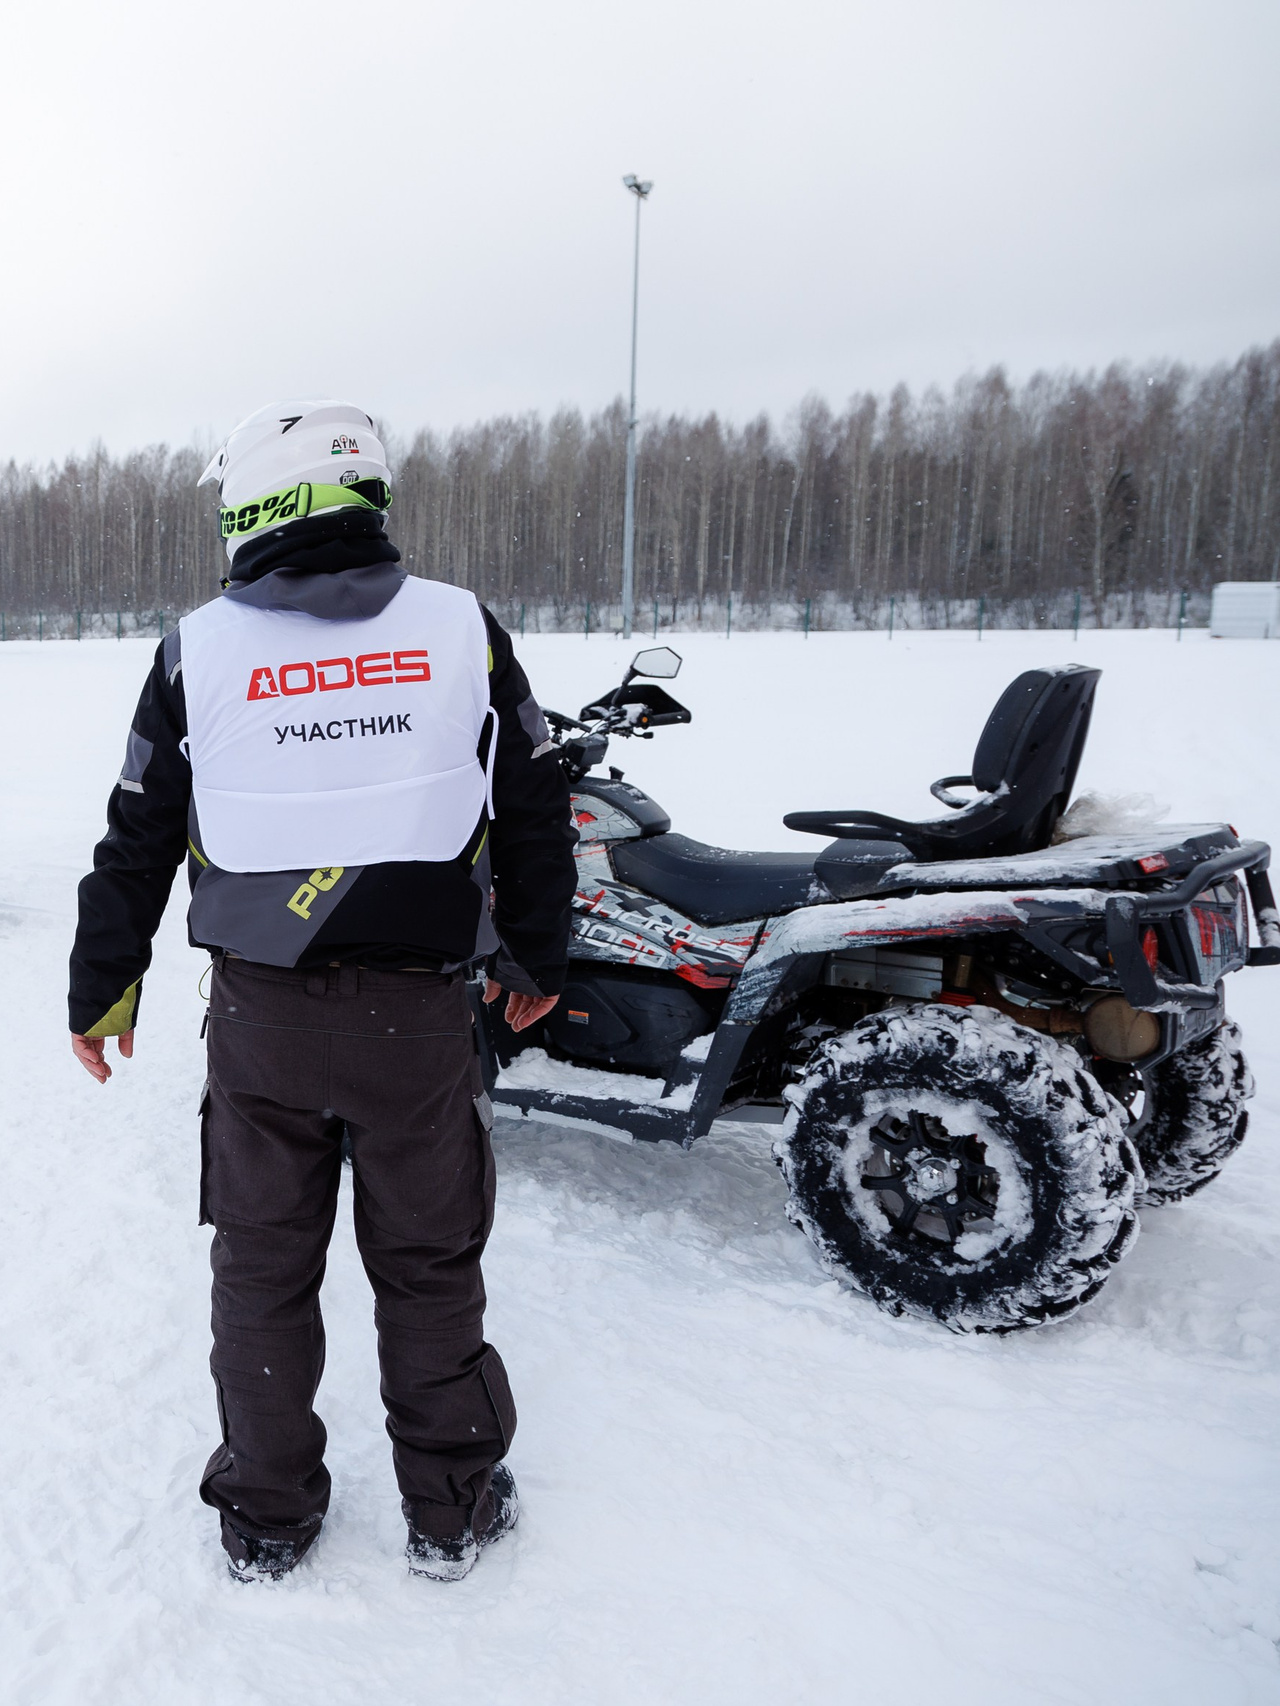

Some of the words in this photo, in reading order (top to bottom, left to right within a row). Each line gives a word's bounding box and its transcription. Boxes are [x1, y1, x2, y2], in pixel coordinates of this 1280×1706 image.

[246, 650, 431, 701] AODES
[274, 713, 412, 744] УЧАСТНИК
[576, 918, 667, 969] 1000
